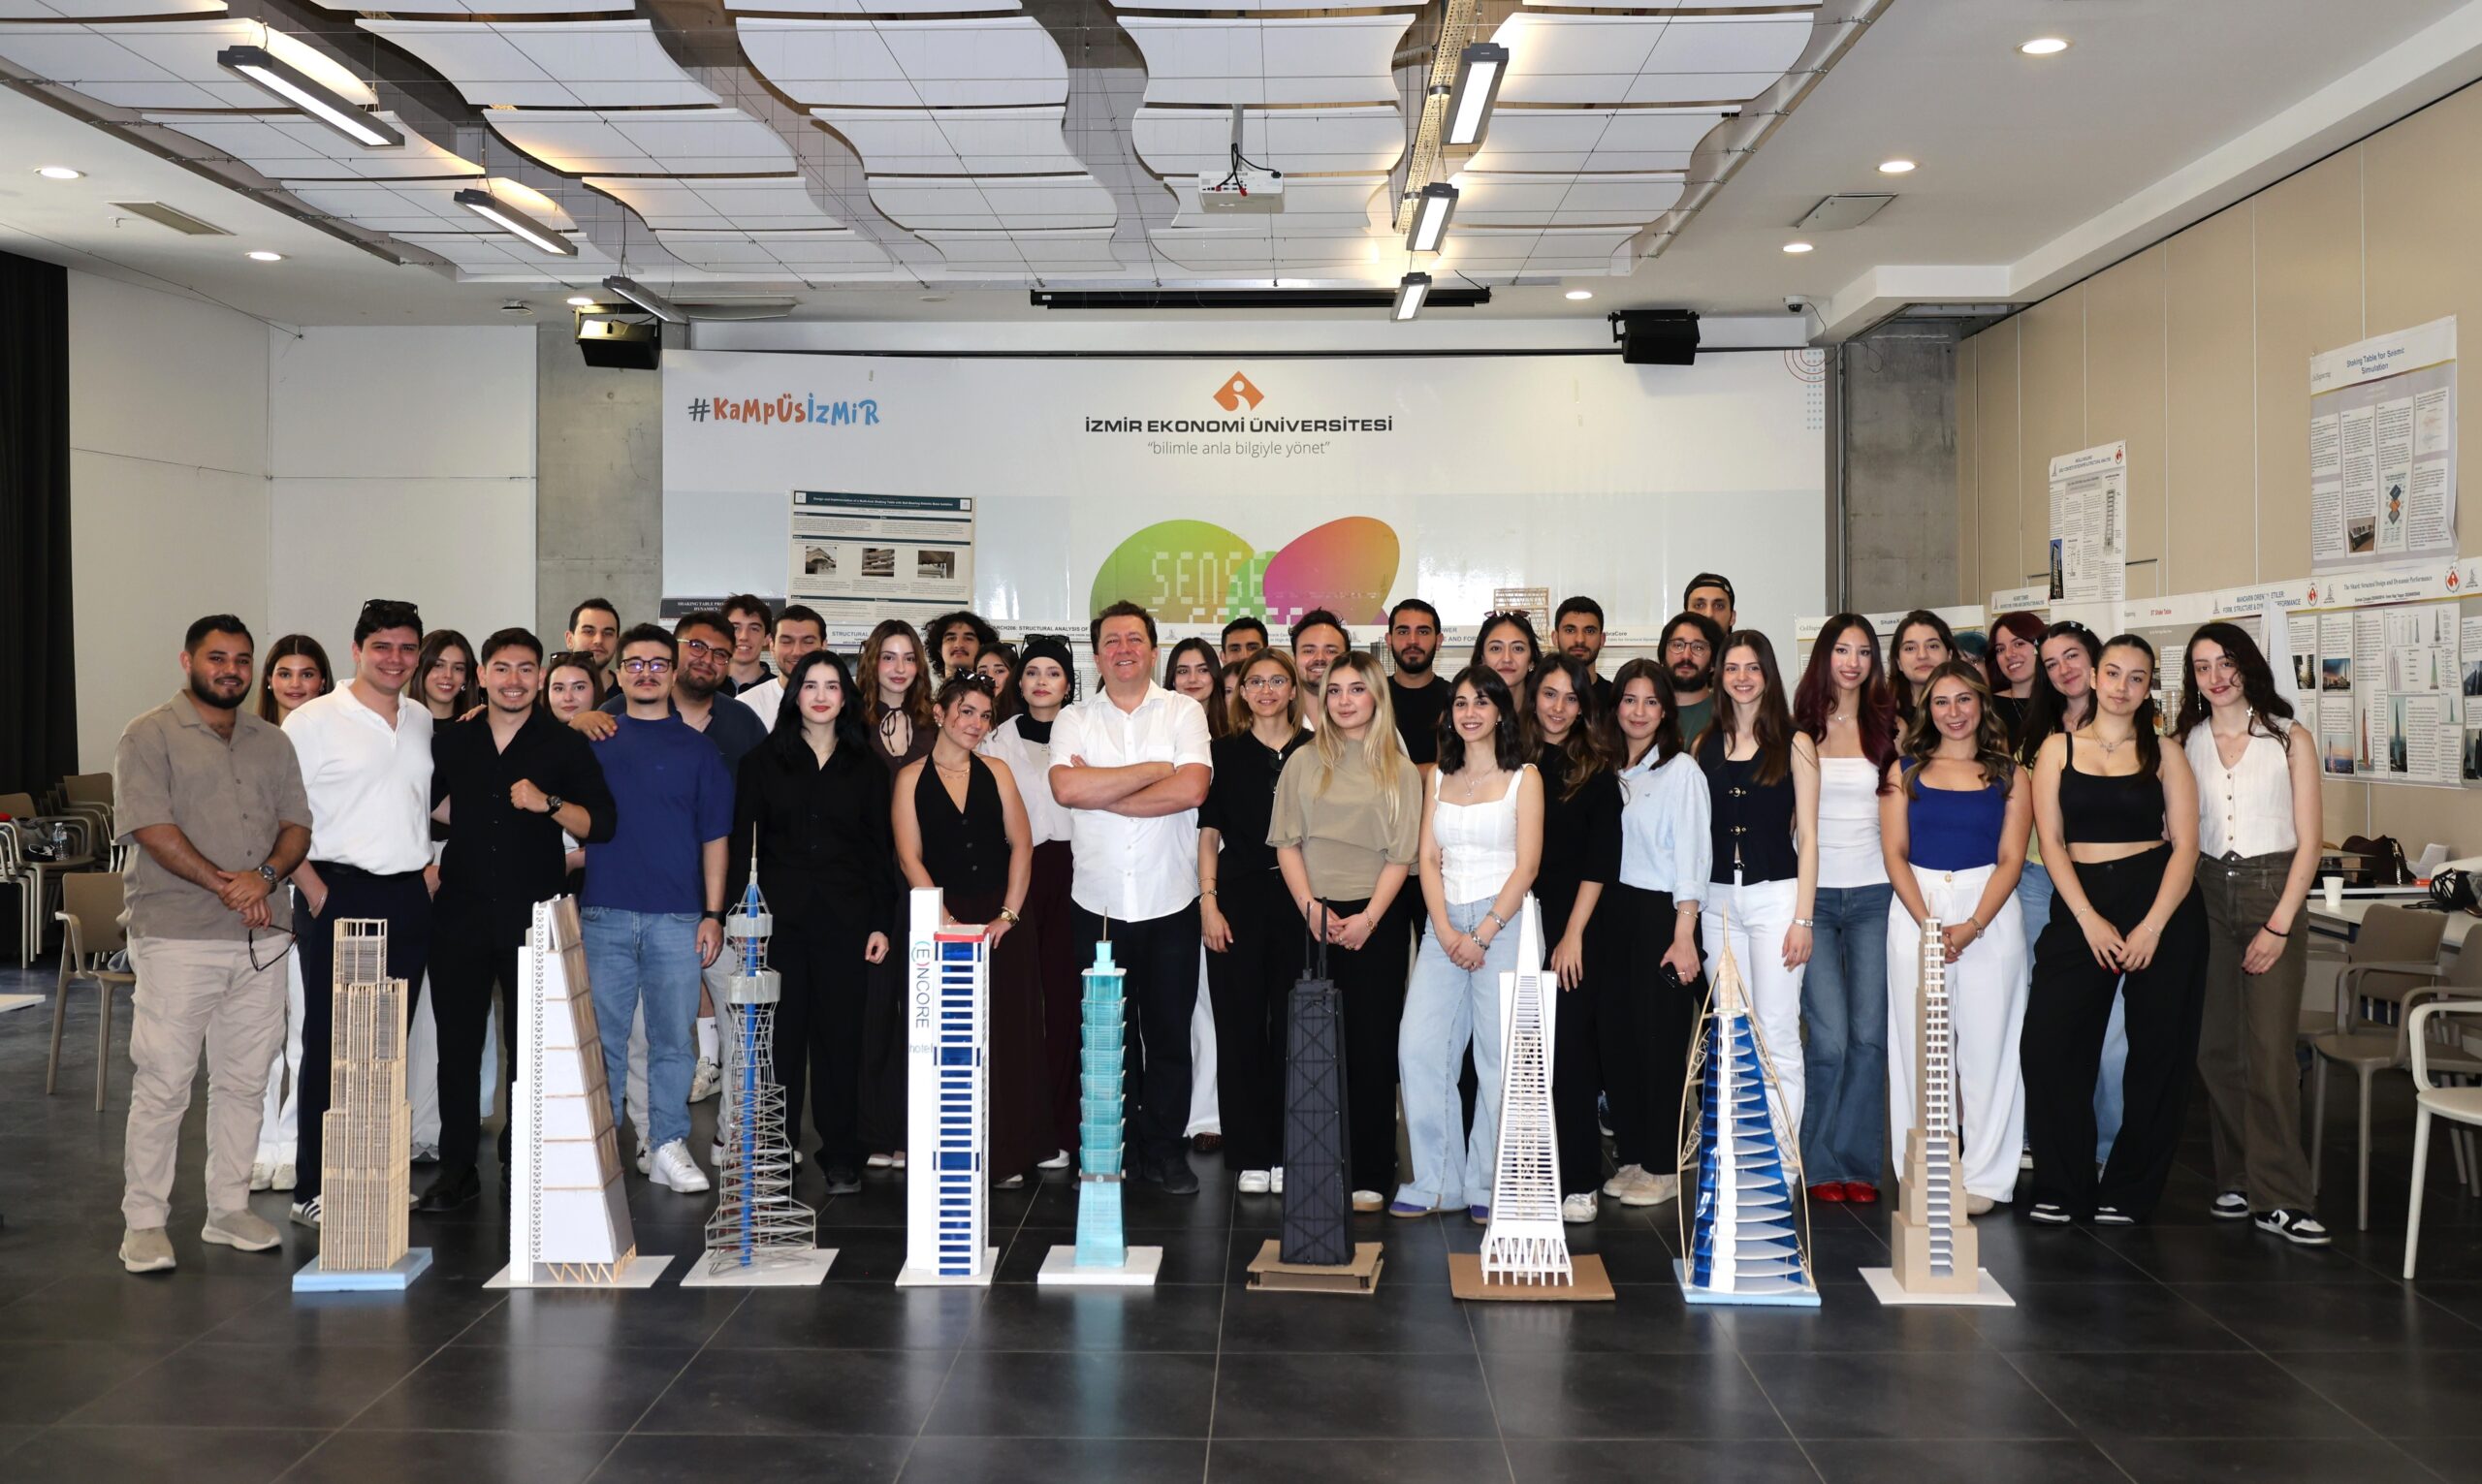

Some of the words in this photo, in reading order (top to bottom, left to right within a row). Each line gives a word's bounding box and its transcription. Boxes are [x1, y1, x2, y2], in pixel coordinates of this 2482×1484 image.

[1085, 416, 1142, 432] İZMİR
[1147, 416, 1245, 432] EKONOMİ
[1249, 415, 1393, 432] ÜNİVERSİTESİ
[1202, 441, 1231, 455] anla
[1235, 441, 1282, 458] bilgiyle
[1152, 552, 1266, 604] SENSE
[909, 1043, 933, 1054] hotel
